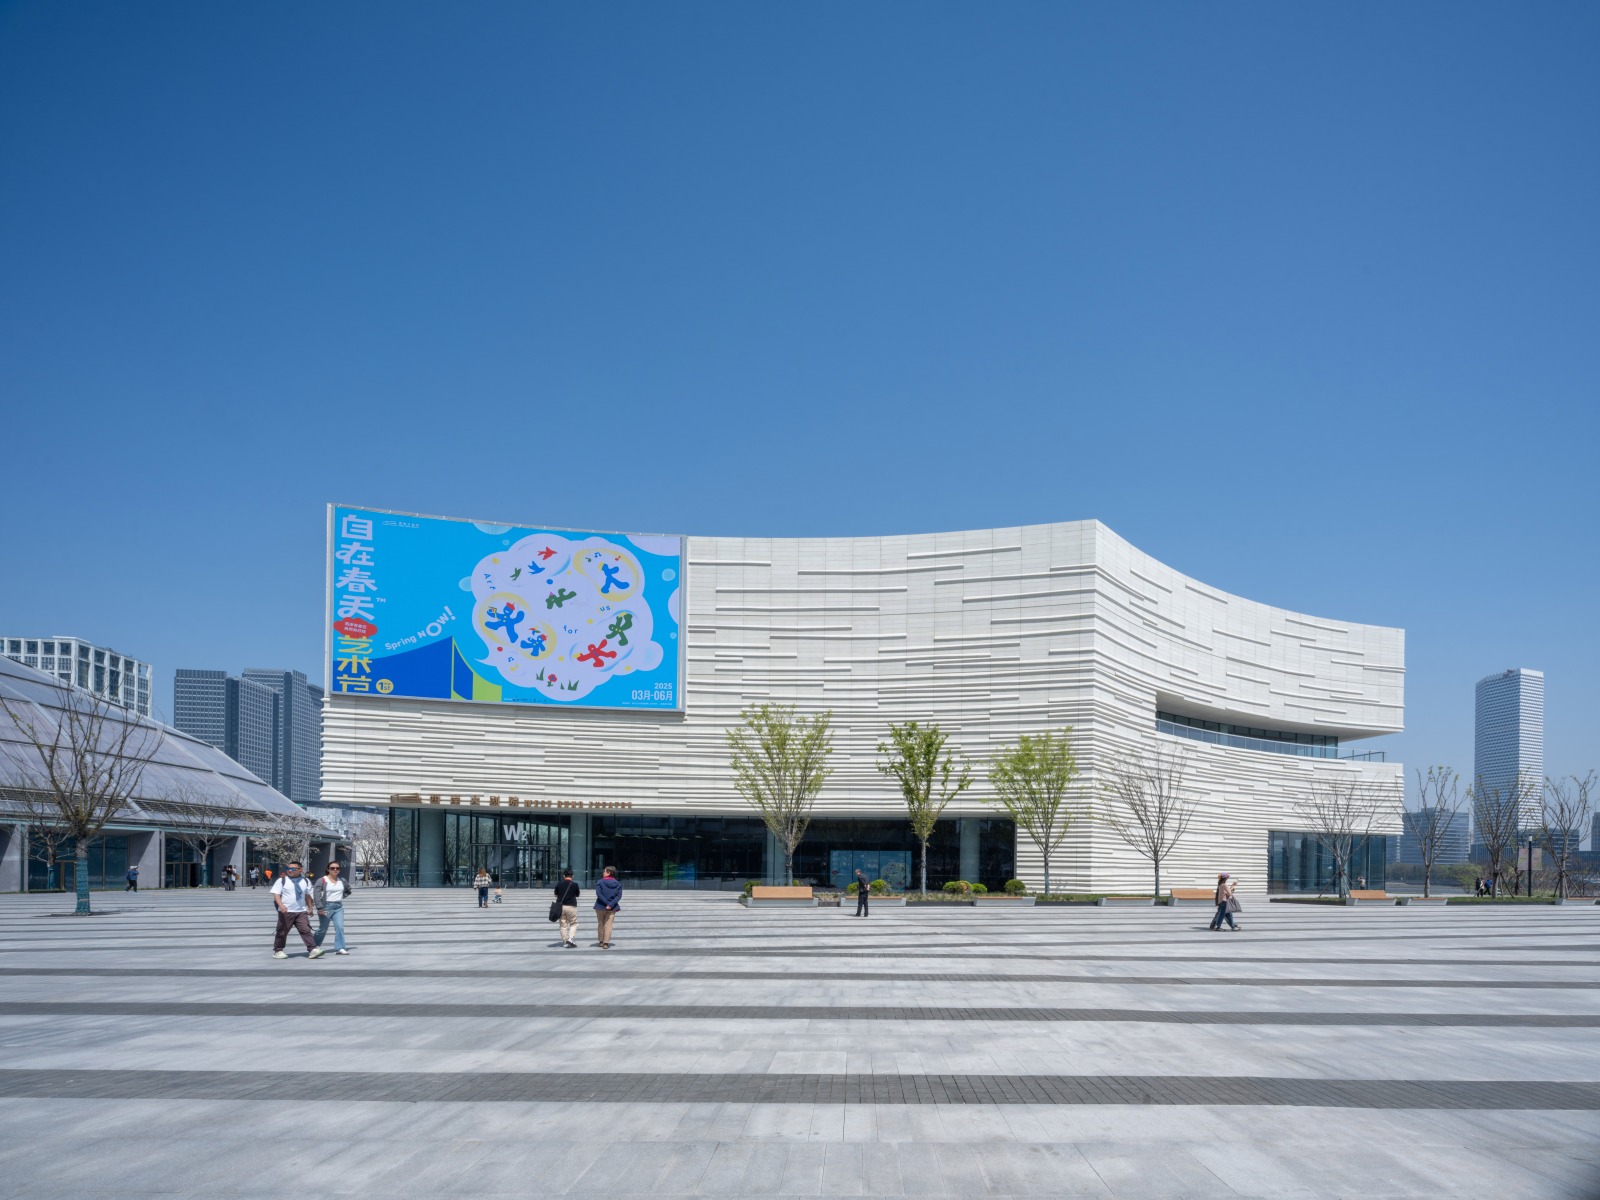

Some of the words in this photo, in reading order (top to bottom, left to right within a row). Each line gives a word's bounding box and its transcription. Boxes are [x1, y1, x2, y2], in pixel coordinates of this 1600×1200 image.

[335, 514, 378, 621] 自在春天
[563, 624, 578, 634] for
[384, 635, 417, 651] Spring
[336, 634, 374, 693] 艺术节
[654, 682, 673, 690] 2025
[631, 689, 673, 701] 03月-06月
[430, 794, 519, 807] 西岸大剧院
